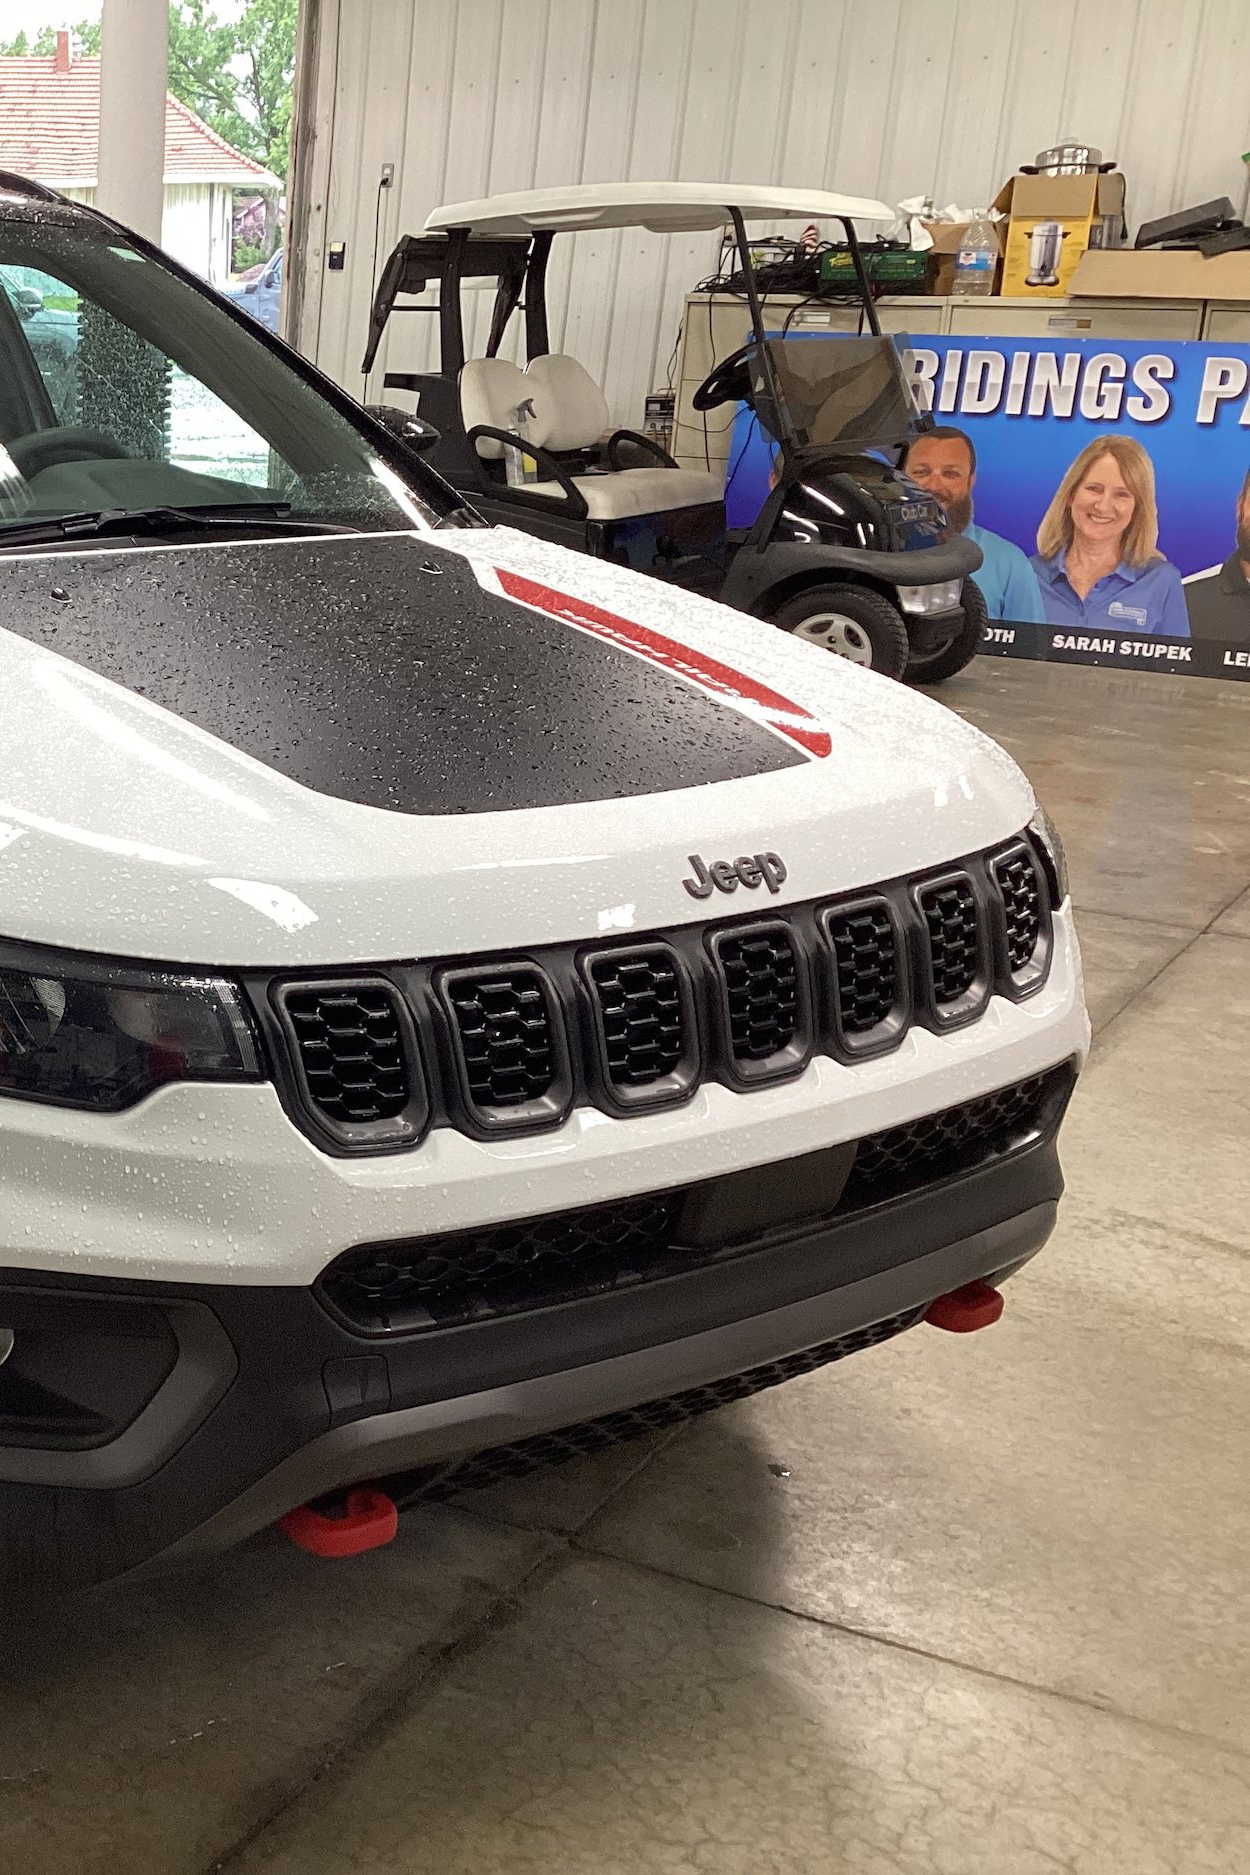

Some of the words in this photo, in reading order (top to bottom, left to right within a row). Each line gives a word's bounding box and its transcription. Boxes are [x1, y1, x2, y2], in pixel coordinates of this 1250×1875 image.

[1196, 356, 1250, 424] P
[1052, 634, 1115, 654] SARAH
[1119, 641, 1192, 662] STUPEK
[682, 852, 787, 899] Jeep
